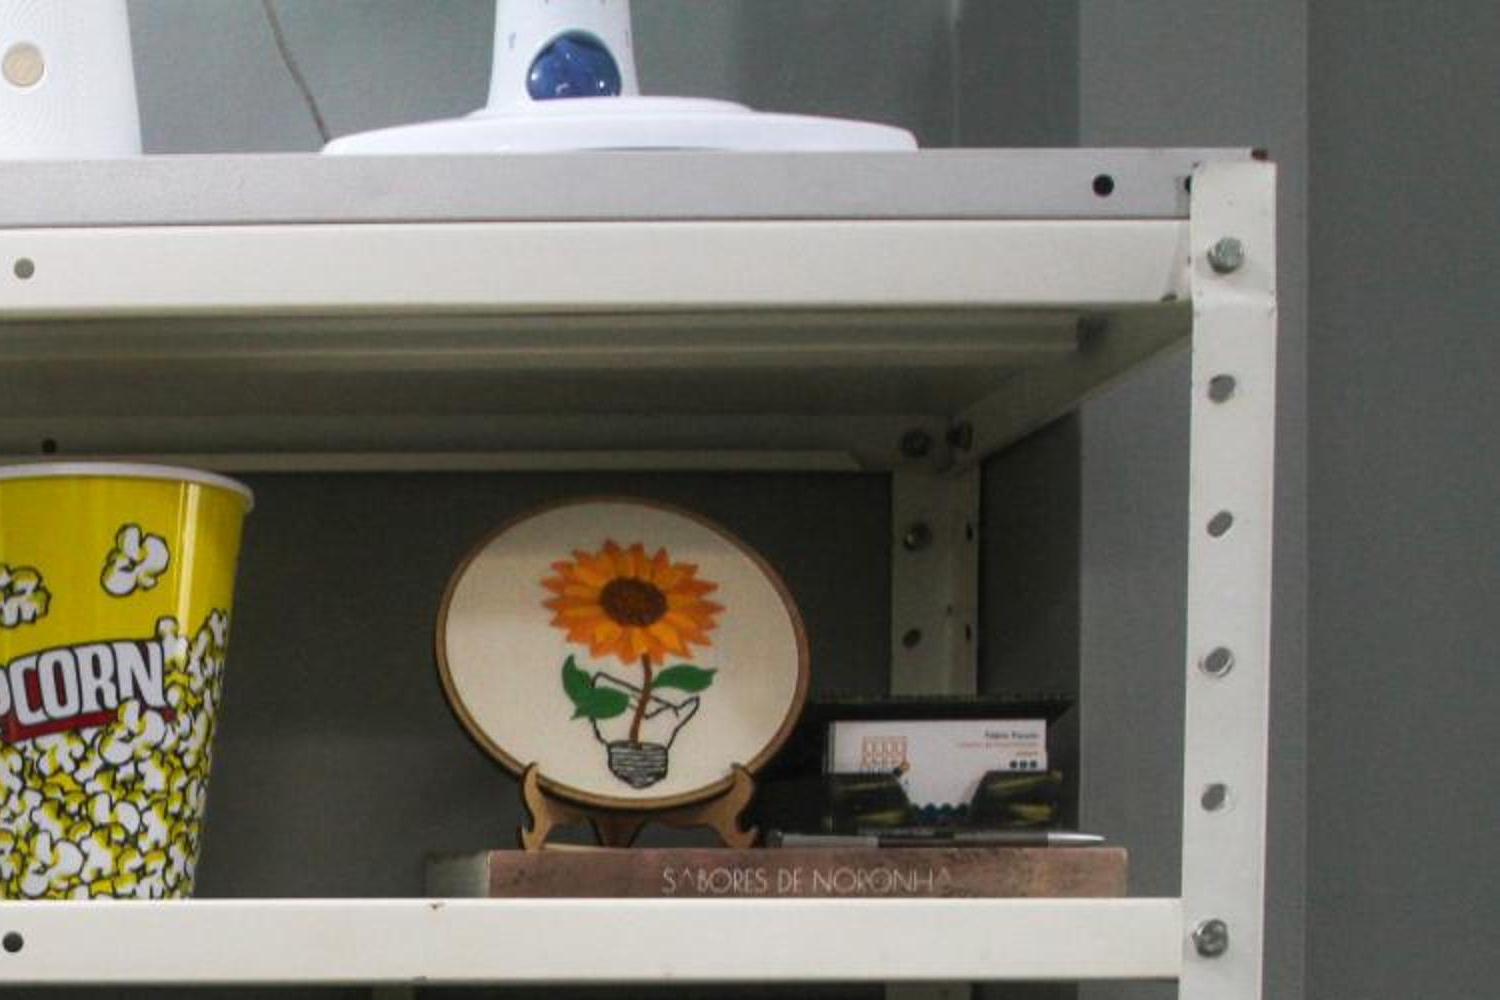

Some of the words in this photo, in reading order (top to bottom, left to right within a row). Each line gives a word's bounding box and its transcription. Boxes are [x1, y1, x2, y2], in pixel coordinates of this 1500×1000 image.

[662, 867, 766, 894] SABORES
[778, 867, 802, 894] DE
[813, 866, 954, 894] NORONHA
